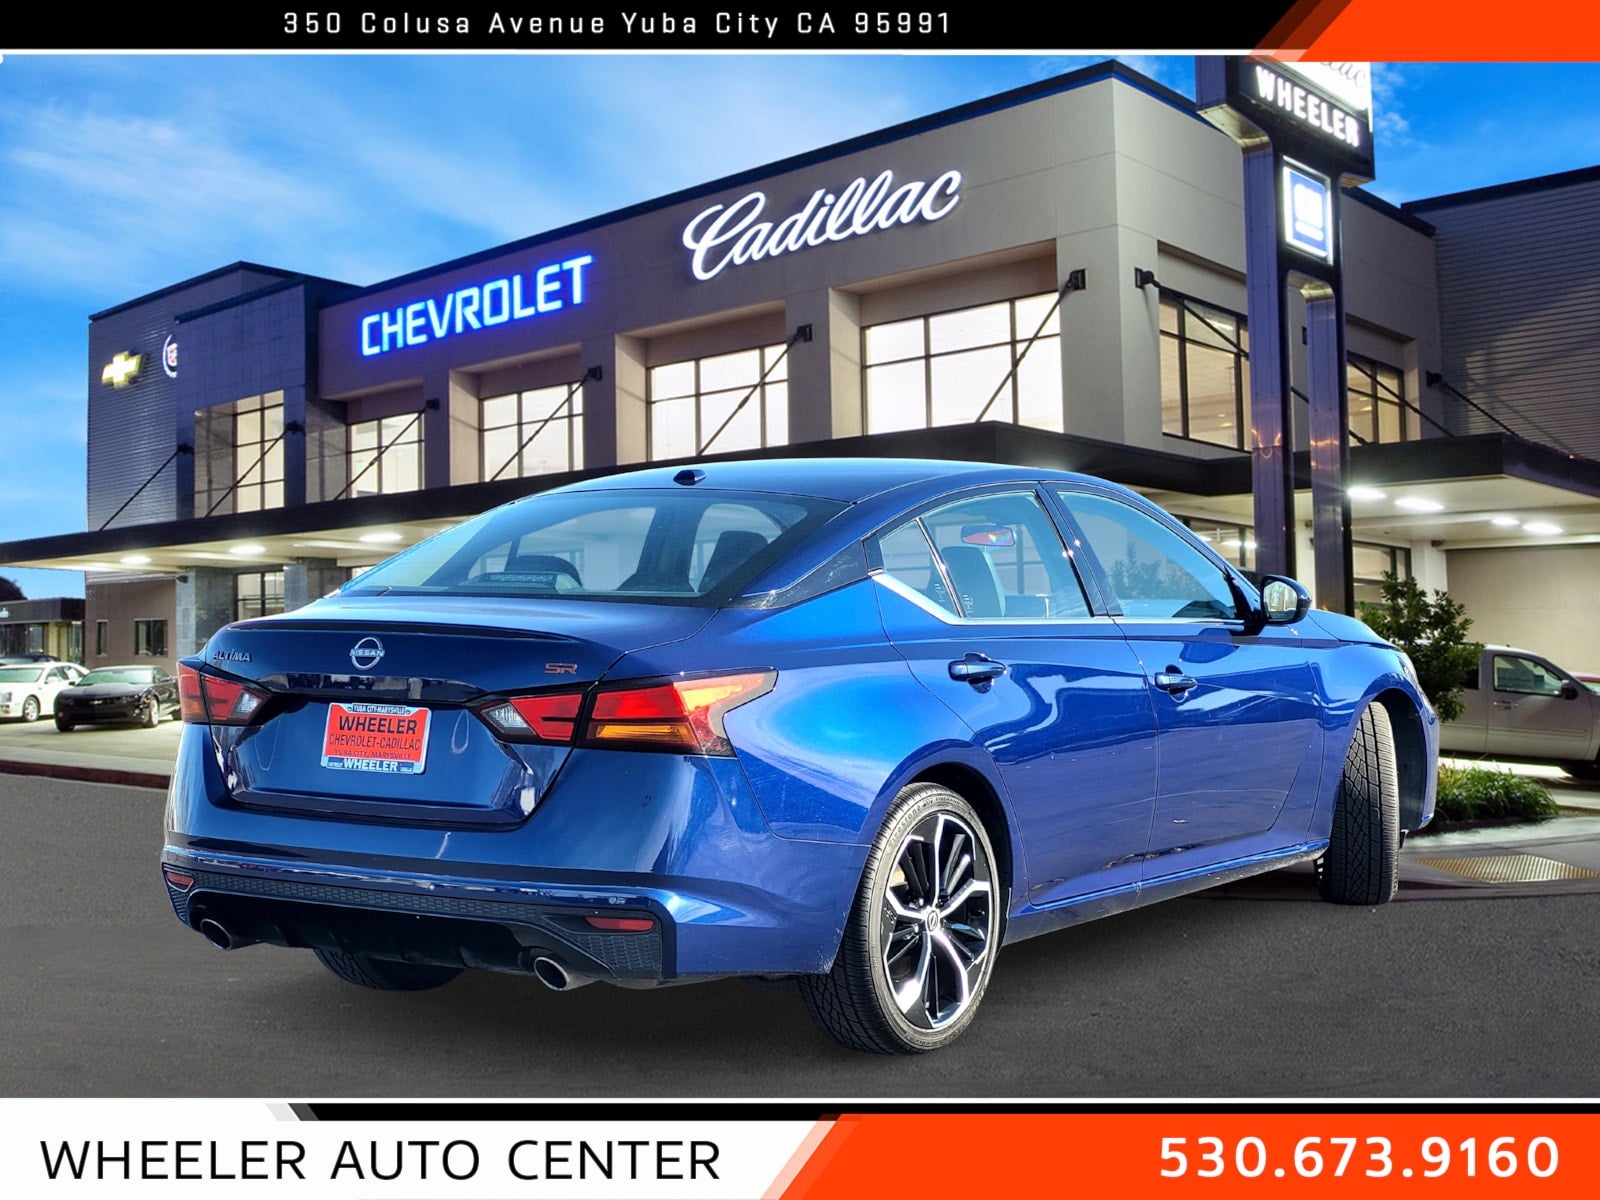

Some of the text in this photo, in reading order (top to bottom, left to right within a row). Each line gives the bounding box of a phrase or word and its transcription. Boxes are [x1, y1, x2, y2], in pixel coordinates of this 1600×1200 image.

[1255, 65, 1360, 148] WHEELER
[682, 169, 962, 281] Cadillac
[361, 255, 593, 357] CHEVROLET
[349, 649, 385, 657] NISSAN
[545, 663, 577, 674] SR
[353, 704, 366, 712] YUBA
[339, 715, 417, 735] WHEELER
[329, 733, 421, 751] CHEVROLET-CADILLAC
[344, 758, 398, 771] WHEELER
